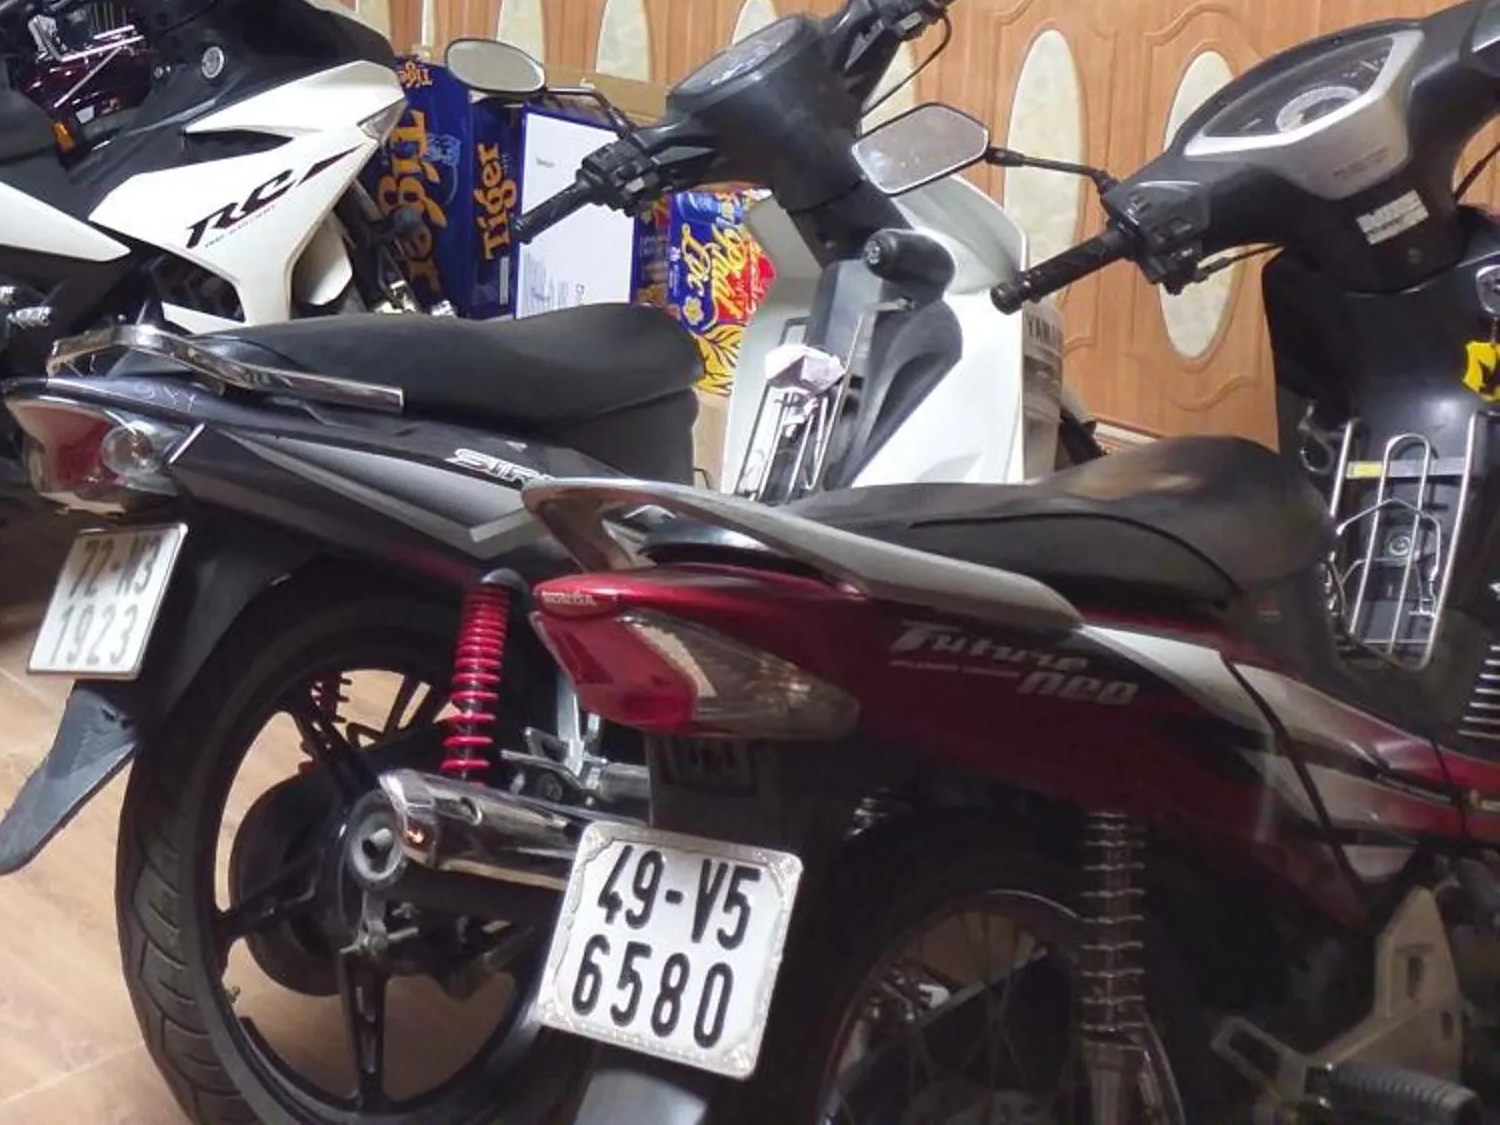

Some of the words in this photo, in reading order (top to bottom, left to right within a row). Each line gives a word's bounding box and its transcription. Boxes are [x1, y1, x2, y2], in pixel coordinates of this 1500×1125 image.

[473, 142, 518, 260] Tiger
[49, 603, 139, 666] 1923
[597, 844, 762, 951] 49-V5
[571, 933, 735, 1049] 6580
